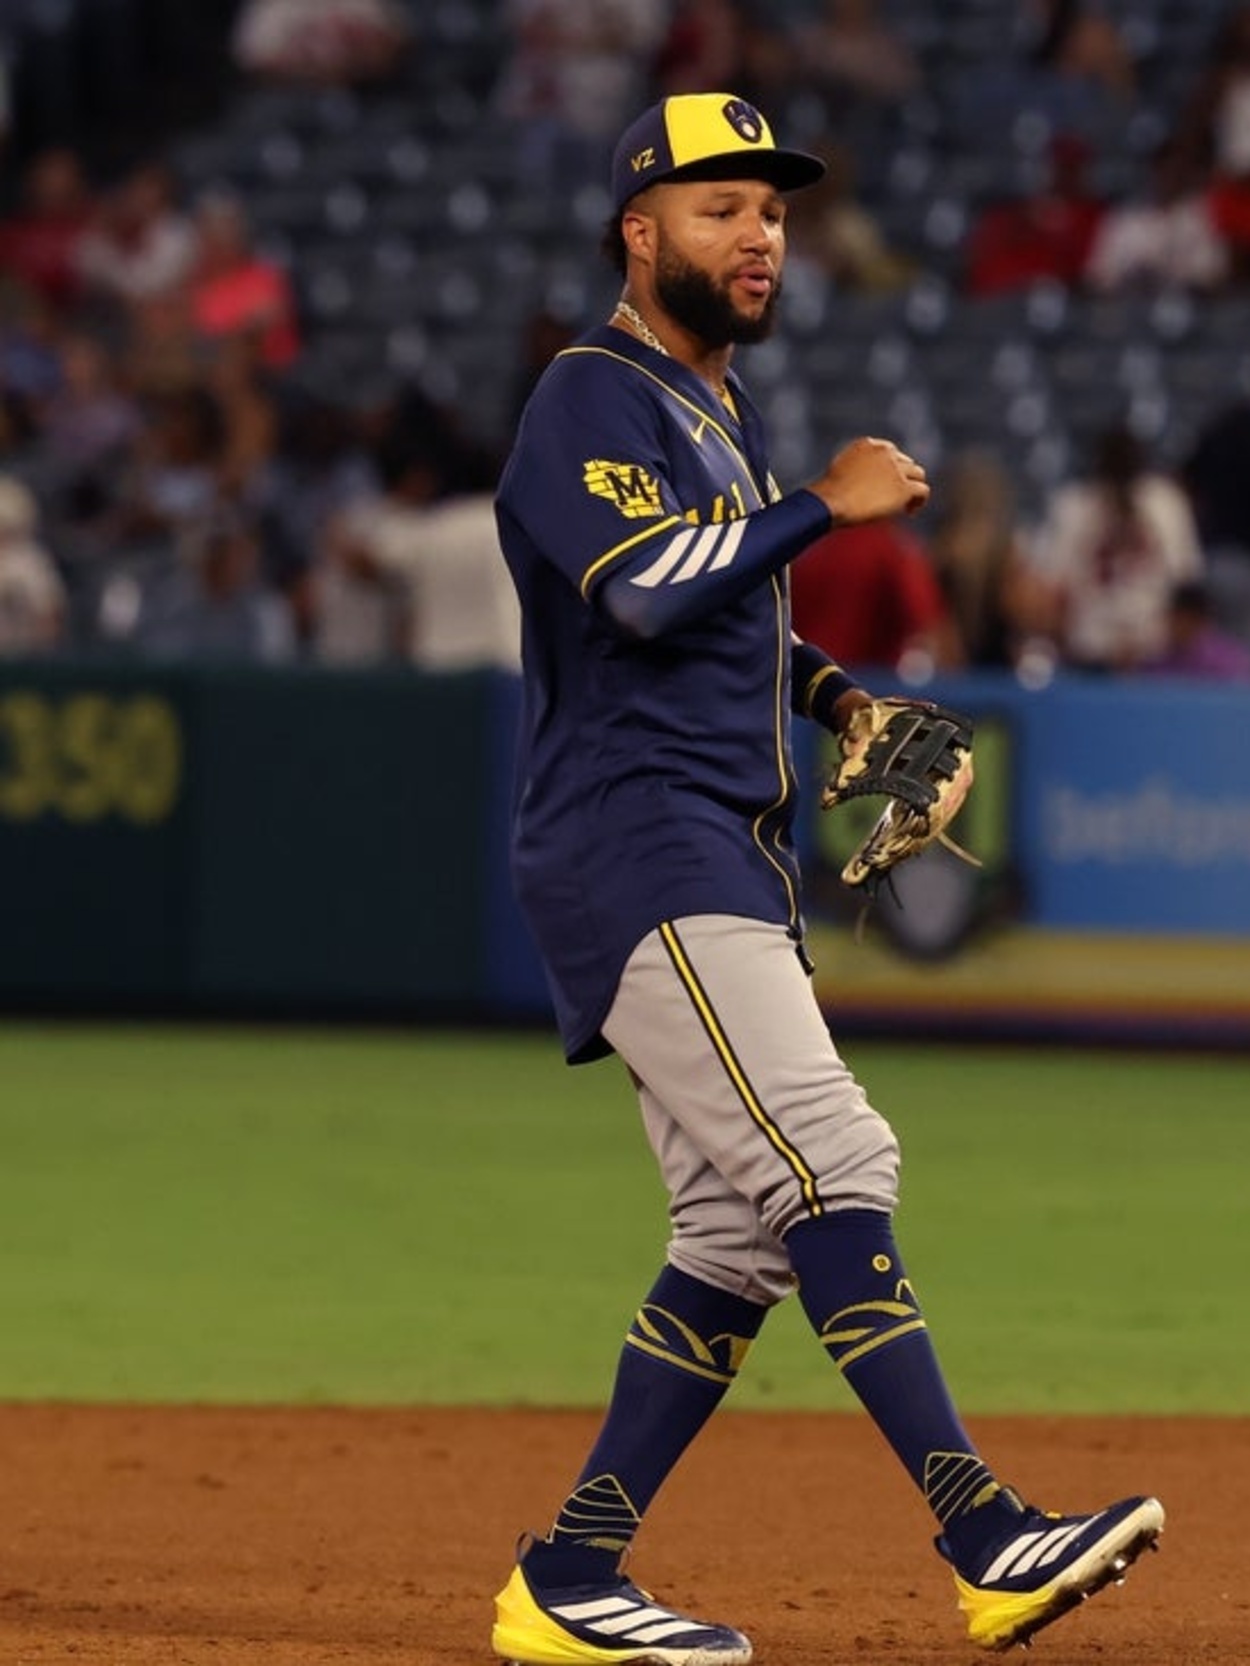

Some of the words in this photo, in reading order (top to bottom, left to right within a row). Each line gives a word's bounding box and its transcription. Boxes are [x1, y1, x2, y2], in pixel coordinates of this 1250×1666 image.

[630, 147, 656, 172] VZ
[604, 467, 655, 508] M
[0, 692, 181, 821] 350
